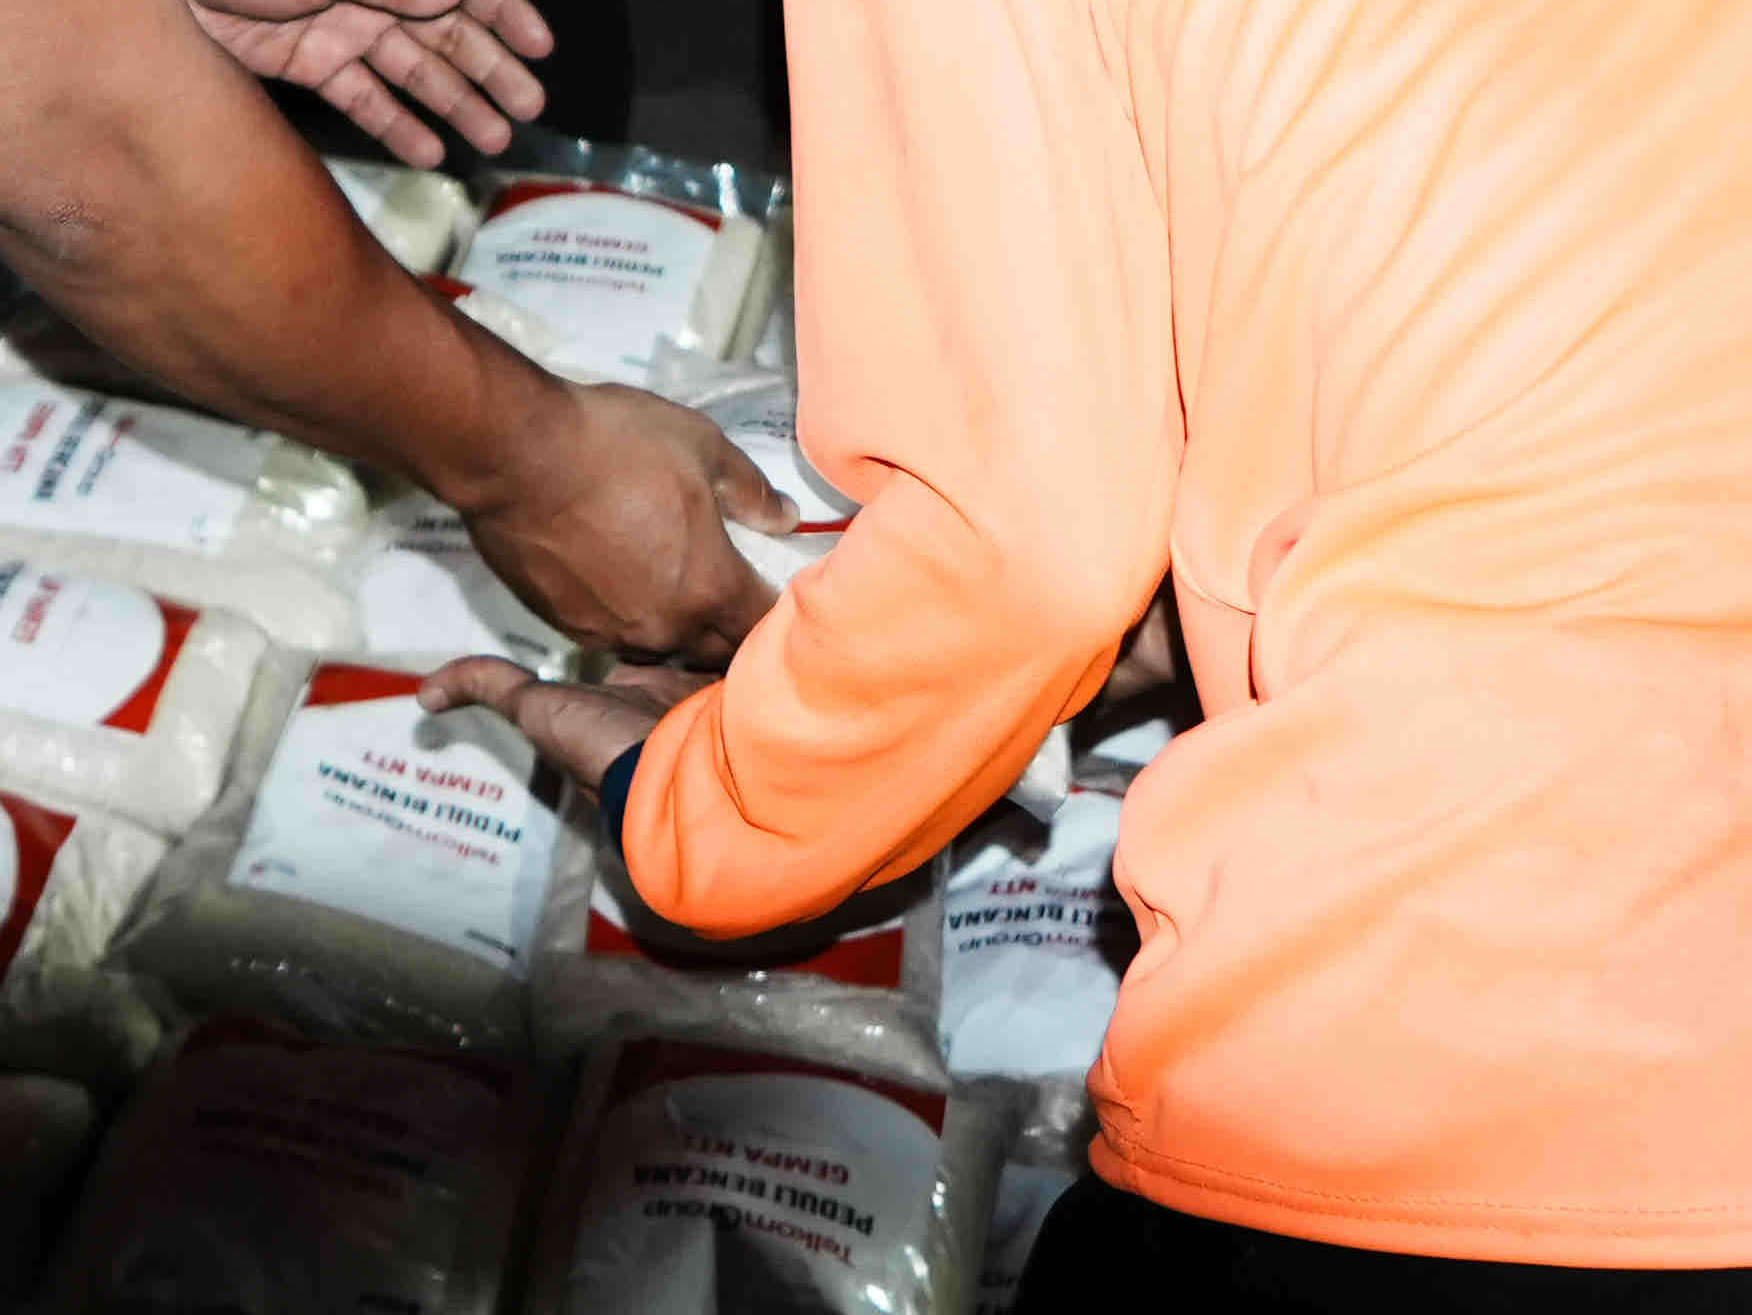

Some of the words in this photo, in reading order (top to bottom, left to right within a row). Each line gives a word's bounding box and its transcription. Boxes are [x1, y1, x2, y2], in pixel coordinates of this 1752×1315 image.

[318, 761, 431, 816] BENCANA
[415, 766, 505, 804] GEMPA
[434, 801, 525, 845] PEDULI
[947, 903, 1066, 931] BENCANA
[633, 1161, 768, 1200] BENCANA
[743, 1144, 850, 1187] GEMPA
[773, 1186, 876, 1238] PEDULI
